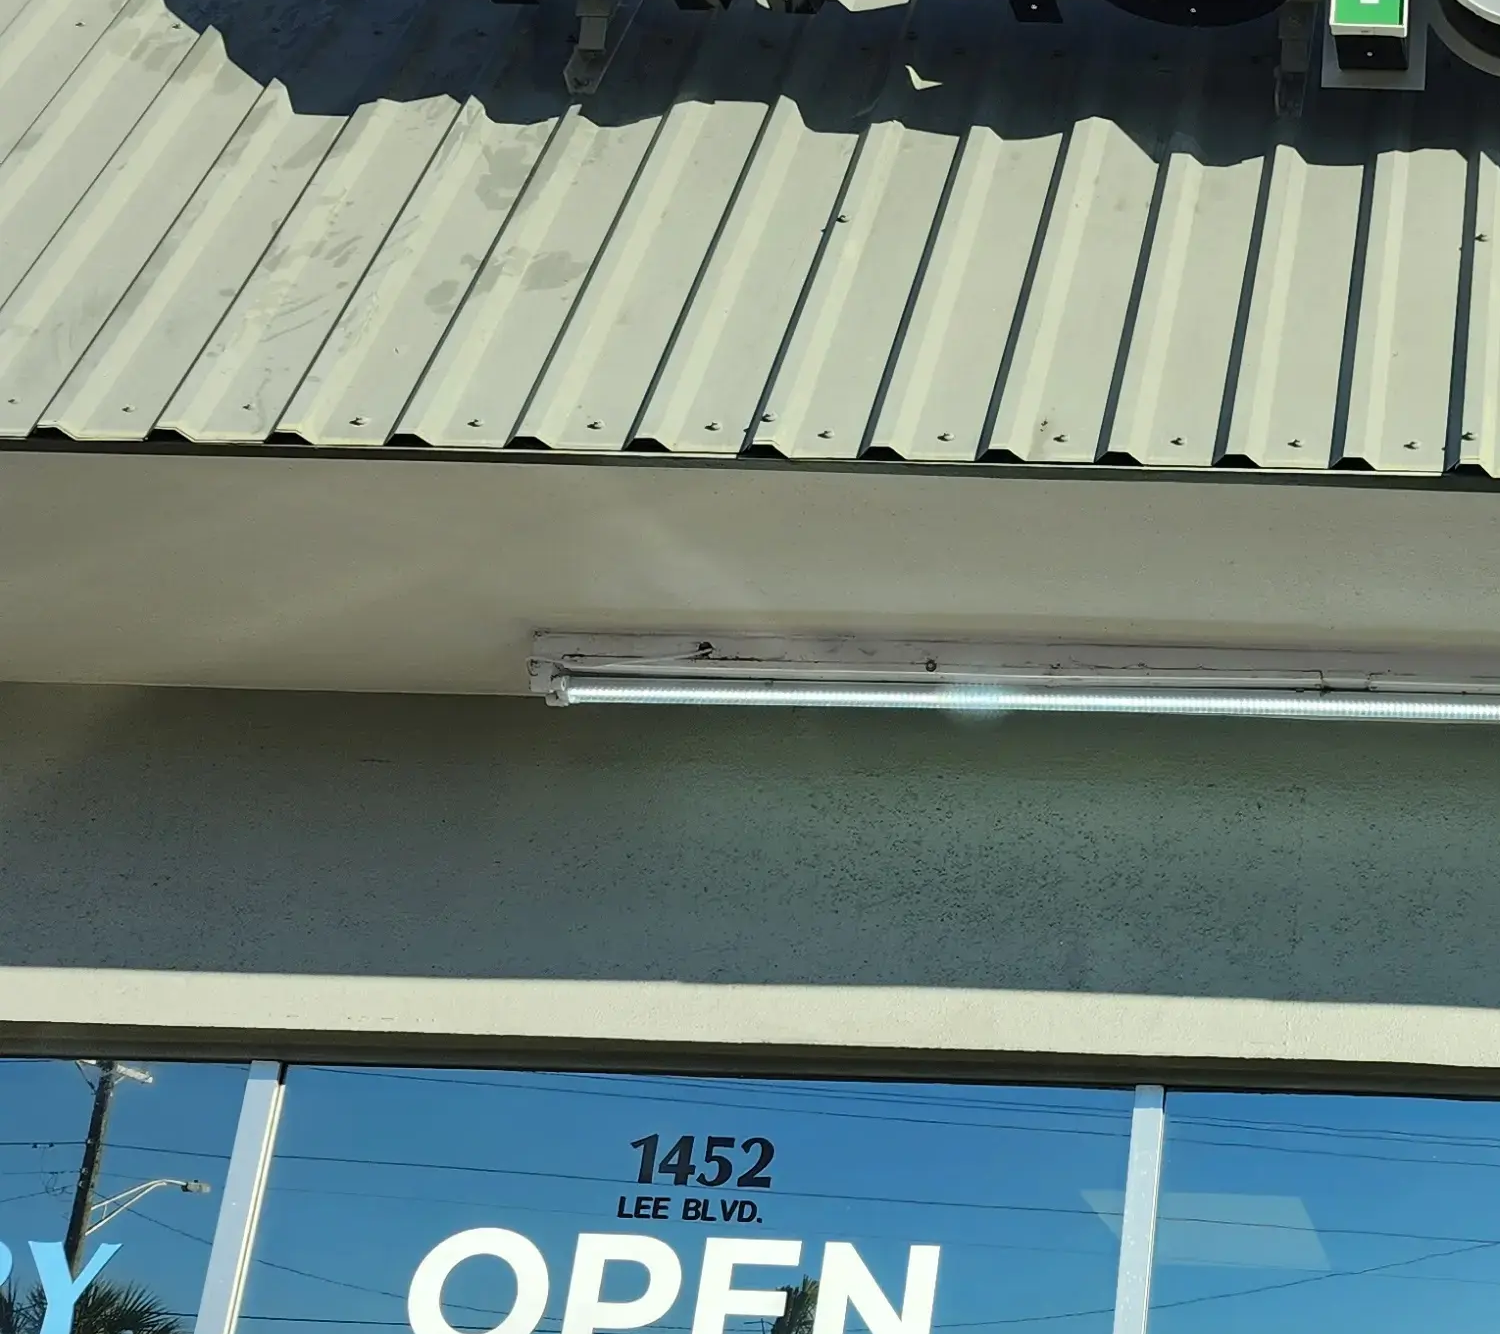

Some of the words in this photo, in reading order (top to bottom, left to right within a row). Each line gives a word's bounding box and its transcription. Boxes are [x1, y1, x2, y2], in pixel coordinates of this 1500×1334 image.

[630, 1133, 775, 1189] 1452
[616, 1195, 671, 1220] LEE
[682, 1198, 763, 1224] BLVD.
